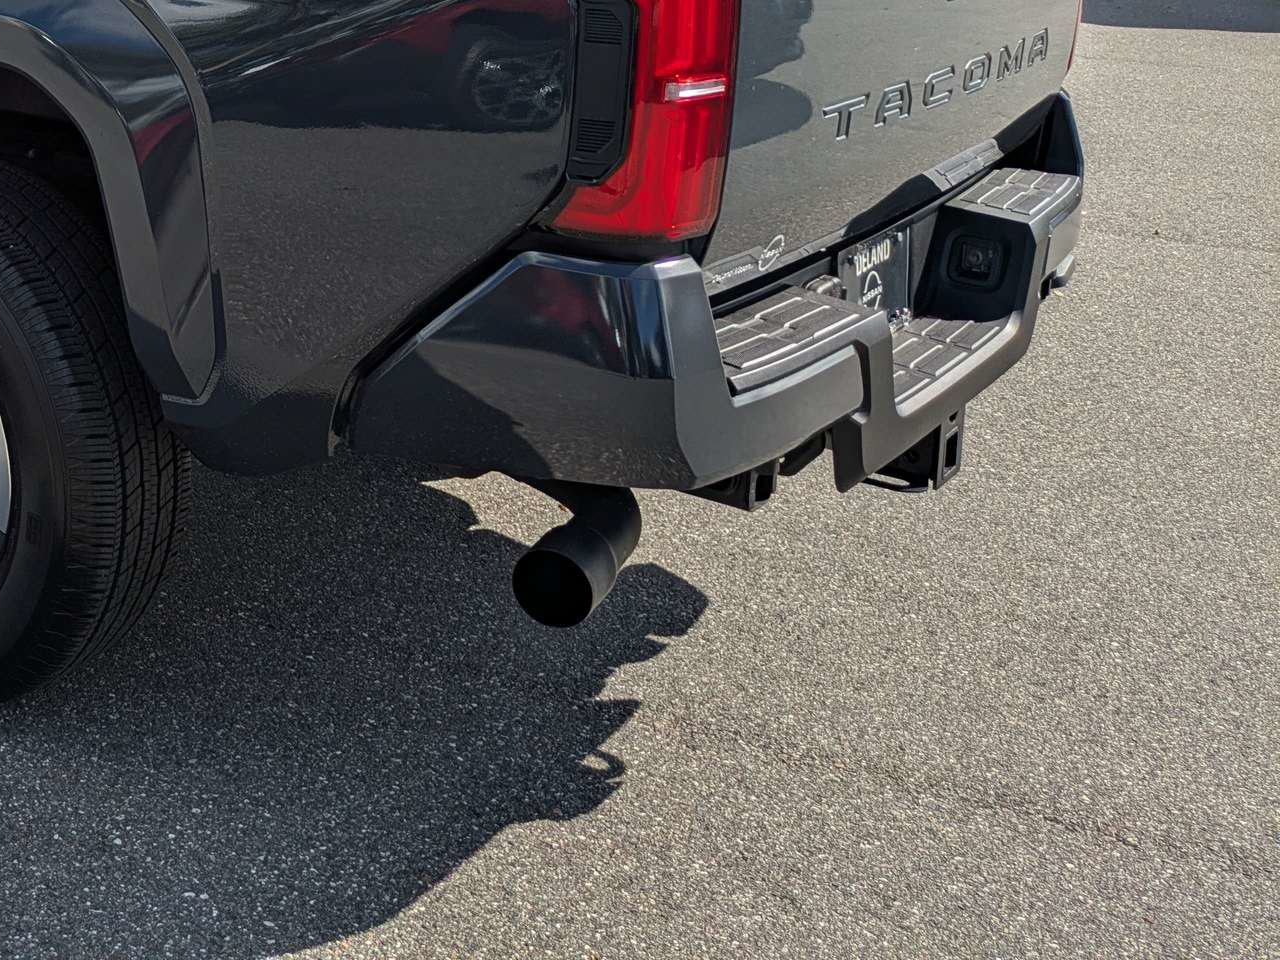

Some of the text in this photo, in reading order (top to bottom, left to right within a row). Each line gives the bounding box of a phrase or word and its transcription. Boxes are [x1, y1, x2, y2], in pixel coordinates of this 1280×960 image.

[823, 27, 1048, 141] TACOMA
[854, 239, 890, 277] DELAND
[862, 285, 883, 304] NISSAN
